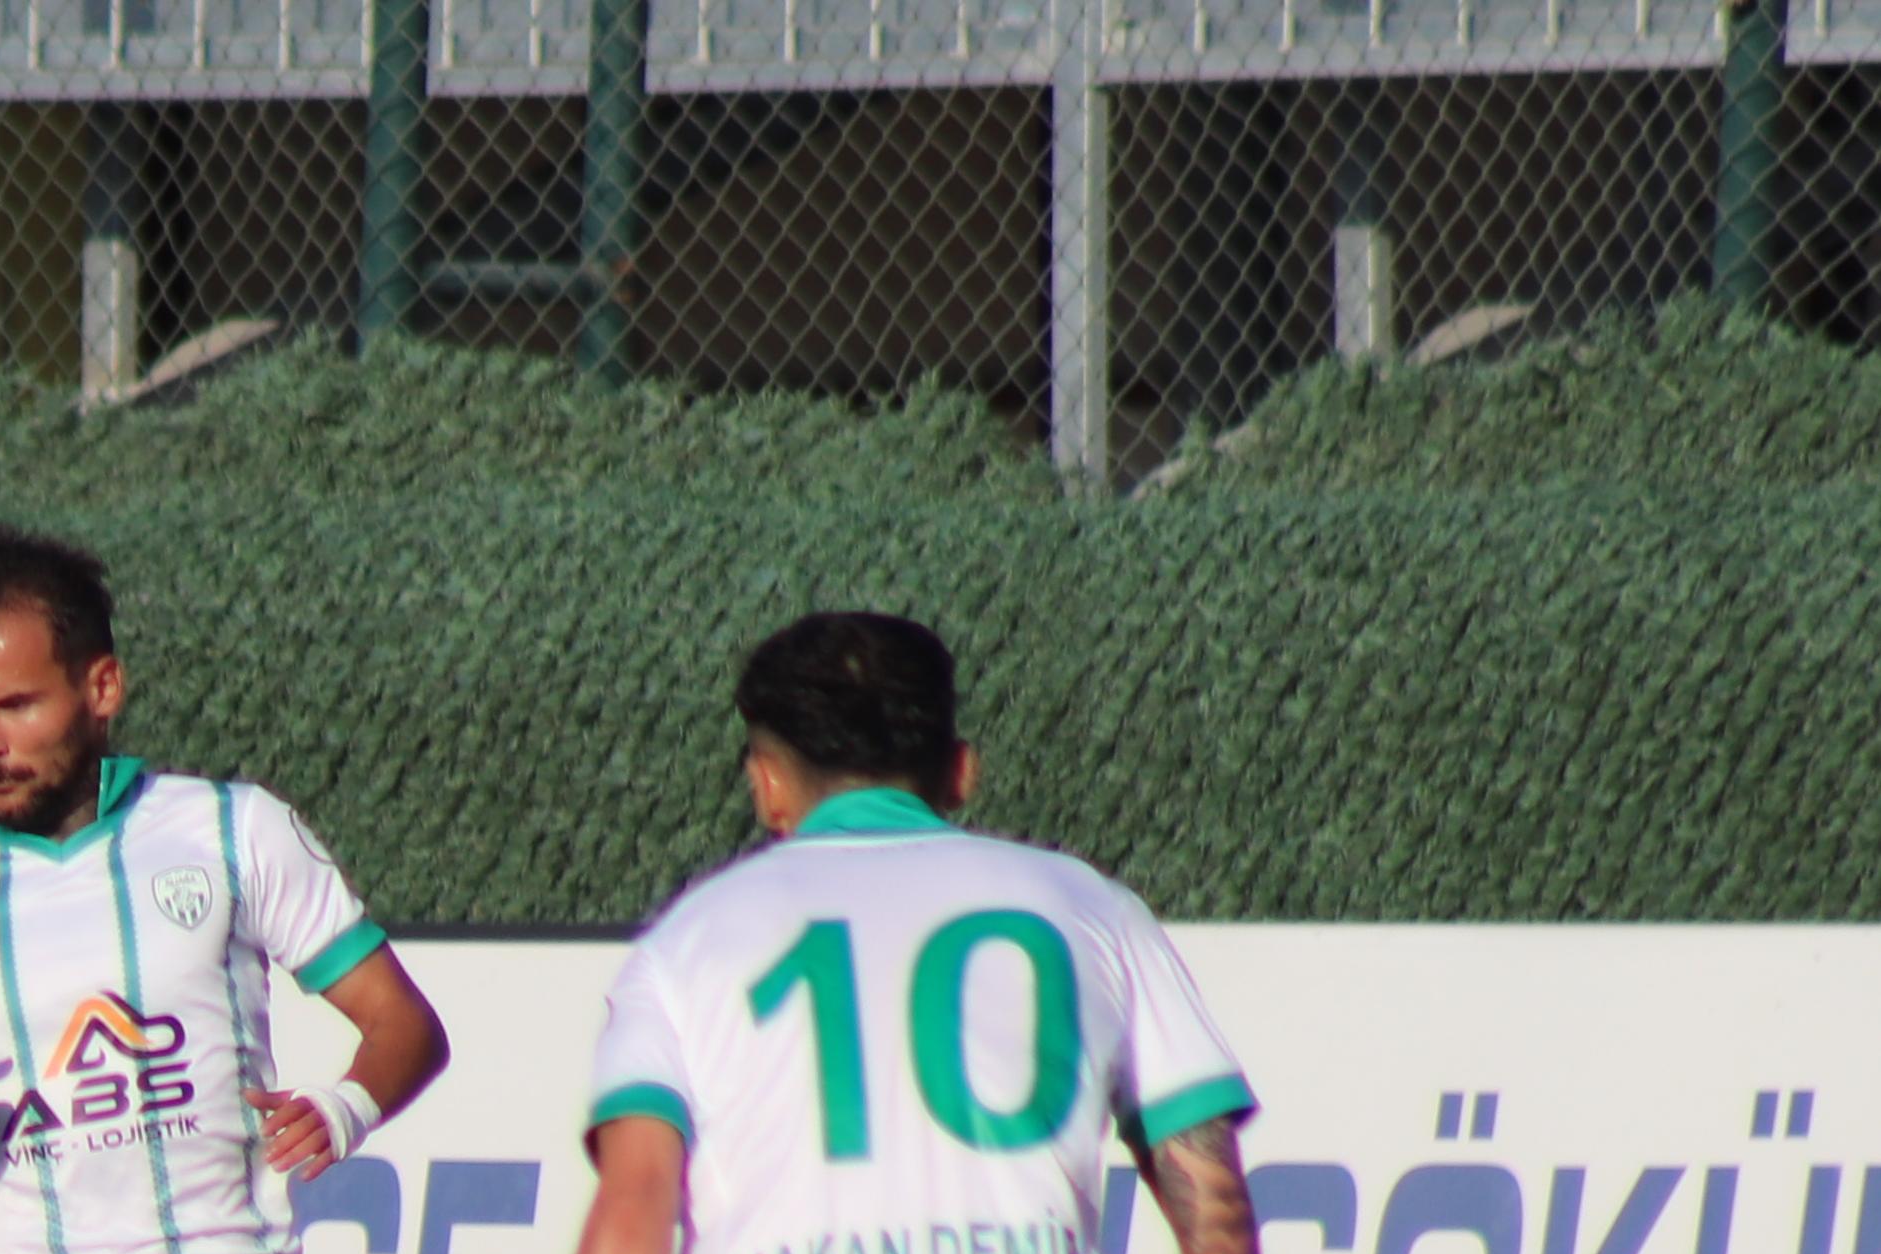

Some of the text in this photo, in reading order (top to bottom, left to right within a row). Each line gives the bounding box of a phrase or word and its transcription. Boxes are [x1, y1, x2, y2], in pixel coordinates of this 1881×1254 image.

[746, 908, 1085, 1163] 10
[2, 1060, 195, 1143] ABS
[86, 1113, 203, 1153] LOJİSTİK
